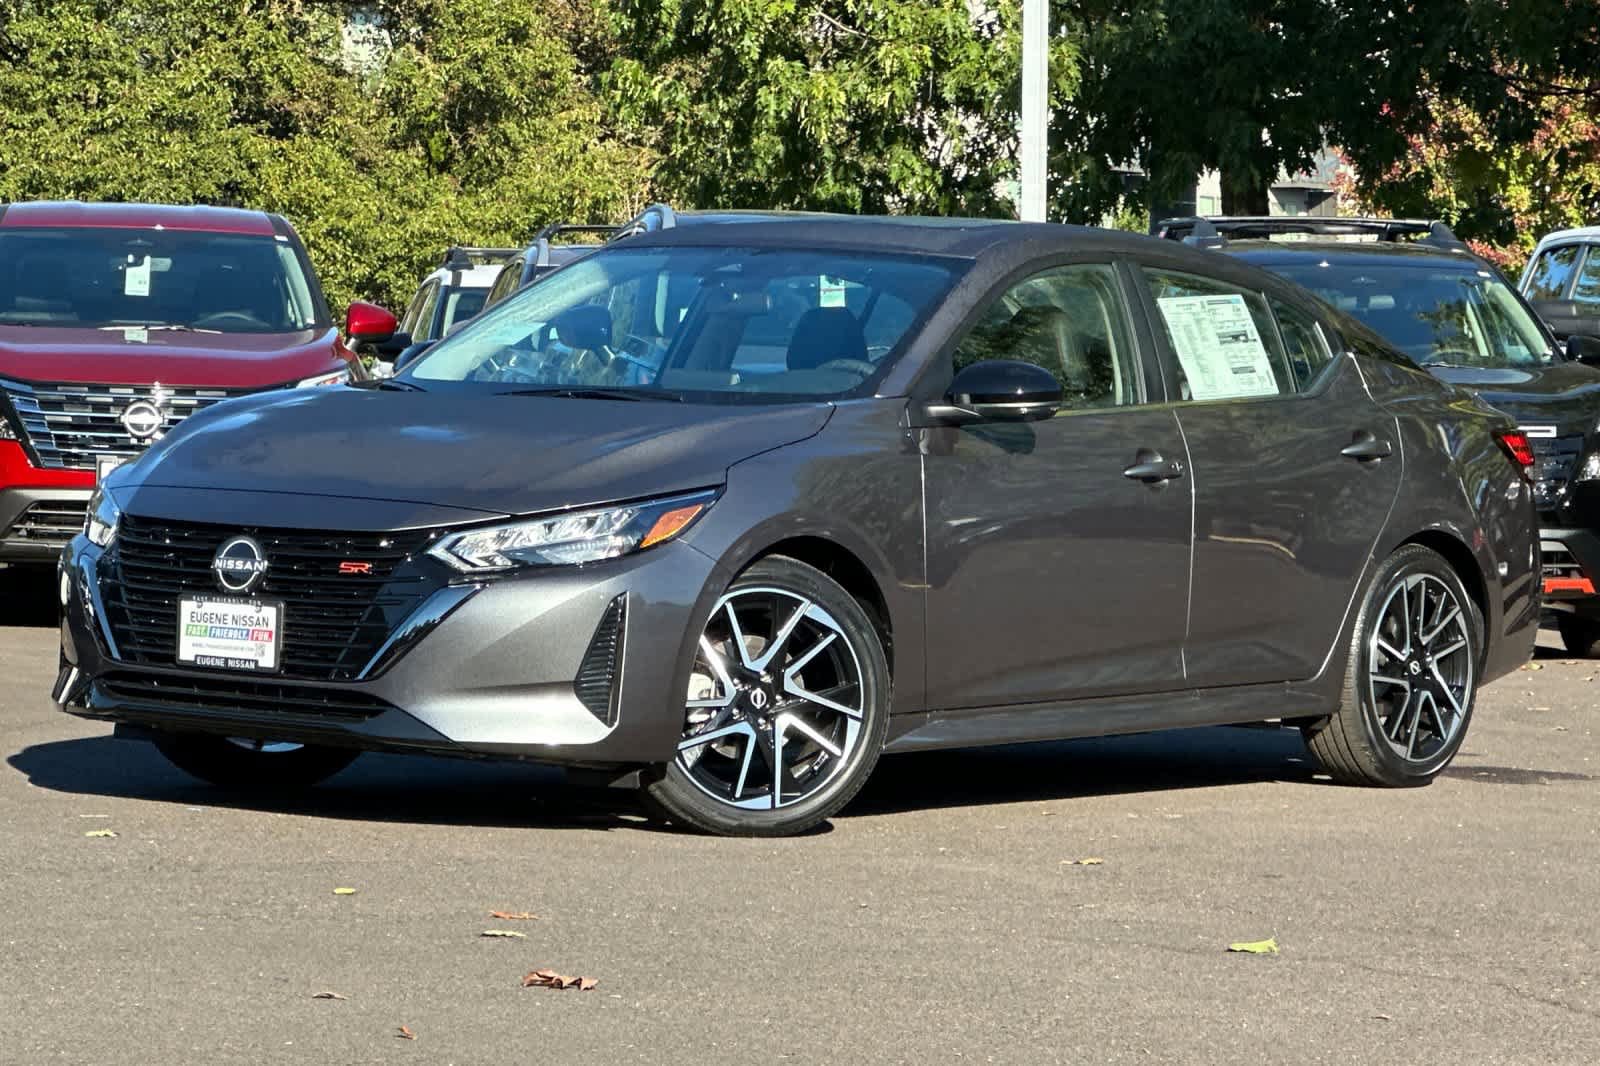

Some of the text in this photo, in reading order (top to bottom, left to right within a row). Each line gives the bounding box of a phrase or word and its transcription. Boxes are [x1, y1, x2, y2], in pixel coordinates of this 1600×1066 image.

[215, 558, 264, 571] NISSAN
[338, 561, 371, 574] SR
[190, 611, 270, 628] EUGENE NISSAN
[196, 656, 256, 669] EUGENE NISSAN
